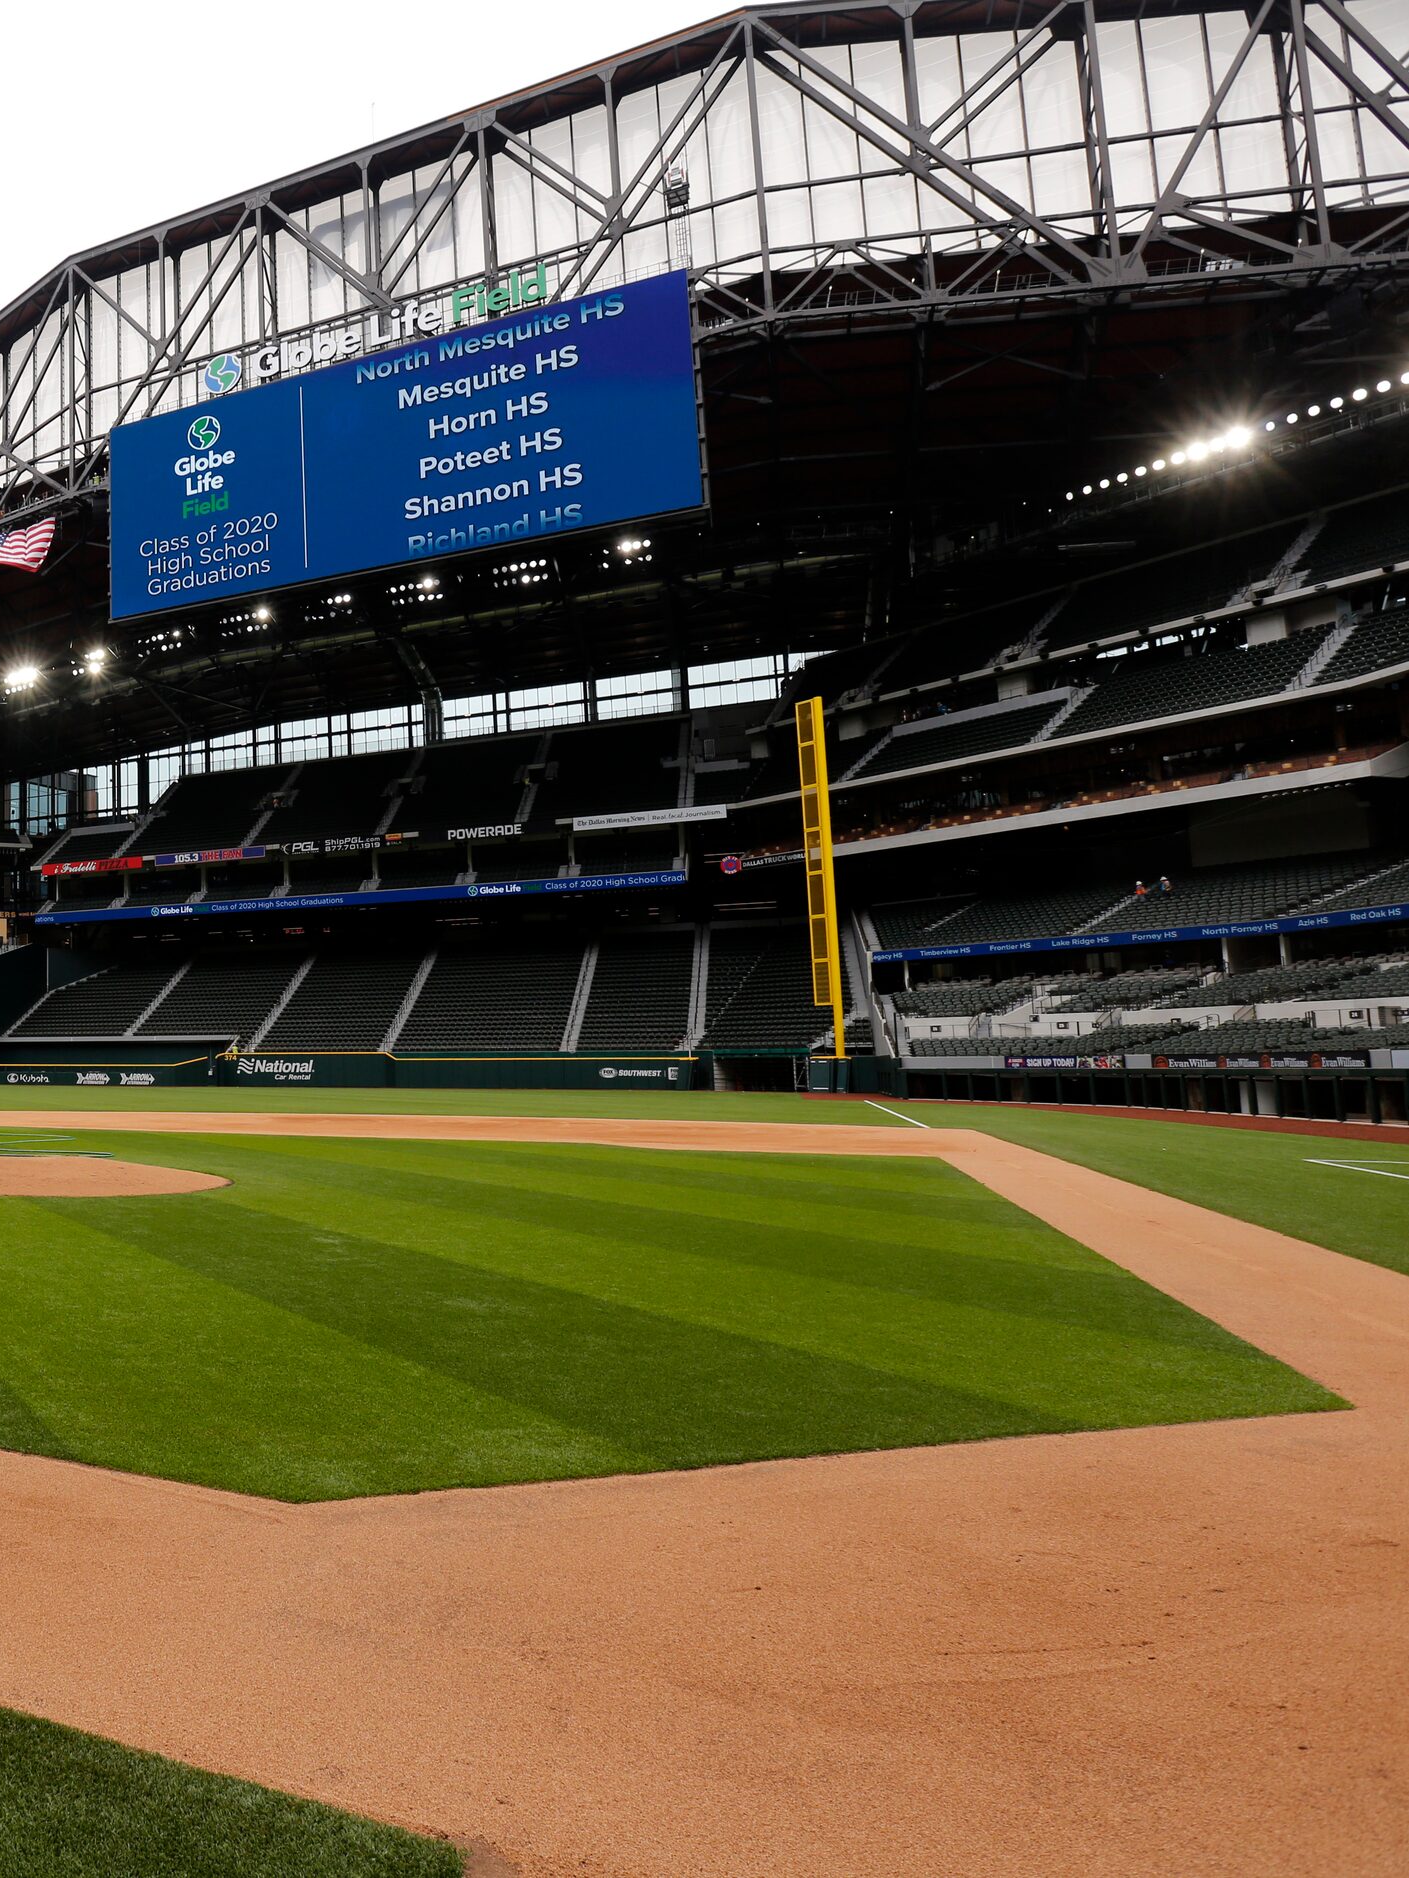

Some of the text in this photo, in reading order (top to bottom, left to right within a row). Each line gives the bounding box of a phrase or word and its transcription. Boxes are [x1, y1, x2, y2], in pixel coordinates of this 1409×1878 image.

[253, 263, 548, 378] Globe Life Field
[356, 293, 625, 384] North Mesquite HS
[398, 345, 579, 410] Mesquite HS
[428, 391, 549, 439] Horn HS
[419, 427, 563, 479] Poteet HS
[174, 450, 236, 476] Globe
[186, 471, 224, 496] Life
[404, 463, 583, 519] Shannon HS
[182, 490, 229, 519] Field
[139, 512, 278, 557] Class of 2020
[408, 503, 583, 558] Richland HS
[148, 534, 270, 576] High School
[147, 559, 271, 596] Graduations
[447, 824, 522, 840] POWERADE
[292, 841, 319, 852] PGL
[325, 837, 380, 846] ShipPGL.com
[325, 842, 380, 852] 877.701.1919
[174, 848, 242, 863] 105.3 THE FAN
[742, 859, 763, 867] DALLAS
[764, 855, 787, 864] TRUCK
[99, 859, 129, 870] PIZZA
[479, 886, 504, 895] Globe
[505, 885, 521, 893] Life
[545, 881, 567, 890] Class
[569, 880, 578, 888] of
[580, 879, 603, 887] 2020
[605, 878, 625, 887] High
[628, 876, 658, 885] School
[160, 907, 180, 915] Globe
[211, 904, 228, 912] Class
[258, 901, 274, 909] High
[276, 899, 299, 907] School
[301, 897, 343, 905] Graduations
[1315, 917, 1328, 925] HS
[1350, 908, 1401, 921] Red Oak HS
[1131, 931, 1177, 942] Forney HS
[1202, 922, 1278, 936] North Forney HS
[989, 942, 1031, 951] Frontier HS
[1051, 936, 1109, 947] Lake Ridge HS
[920, 948, 959, 957] Timberview
[1026, 1058, 1042, 1067] SIGN
[1042, 1058, 1051, 1067] UP
[1052, 1058, 1075, 1066] TODAY
[20, 1074, 50, 1083] Kubota
[618, 1069, 662, 1077] SOUTHWEST
